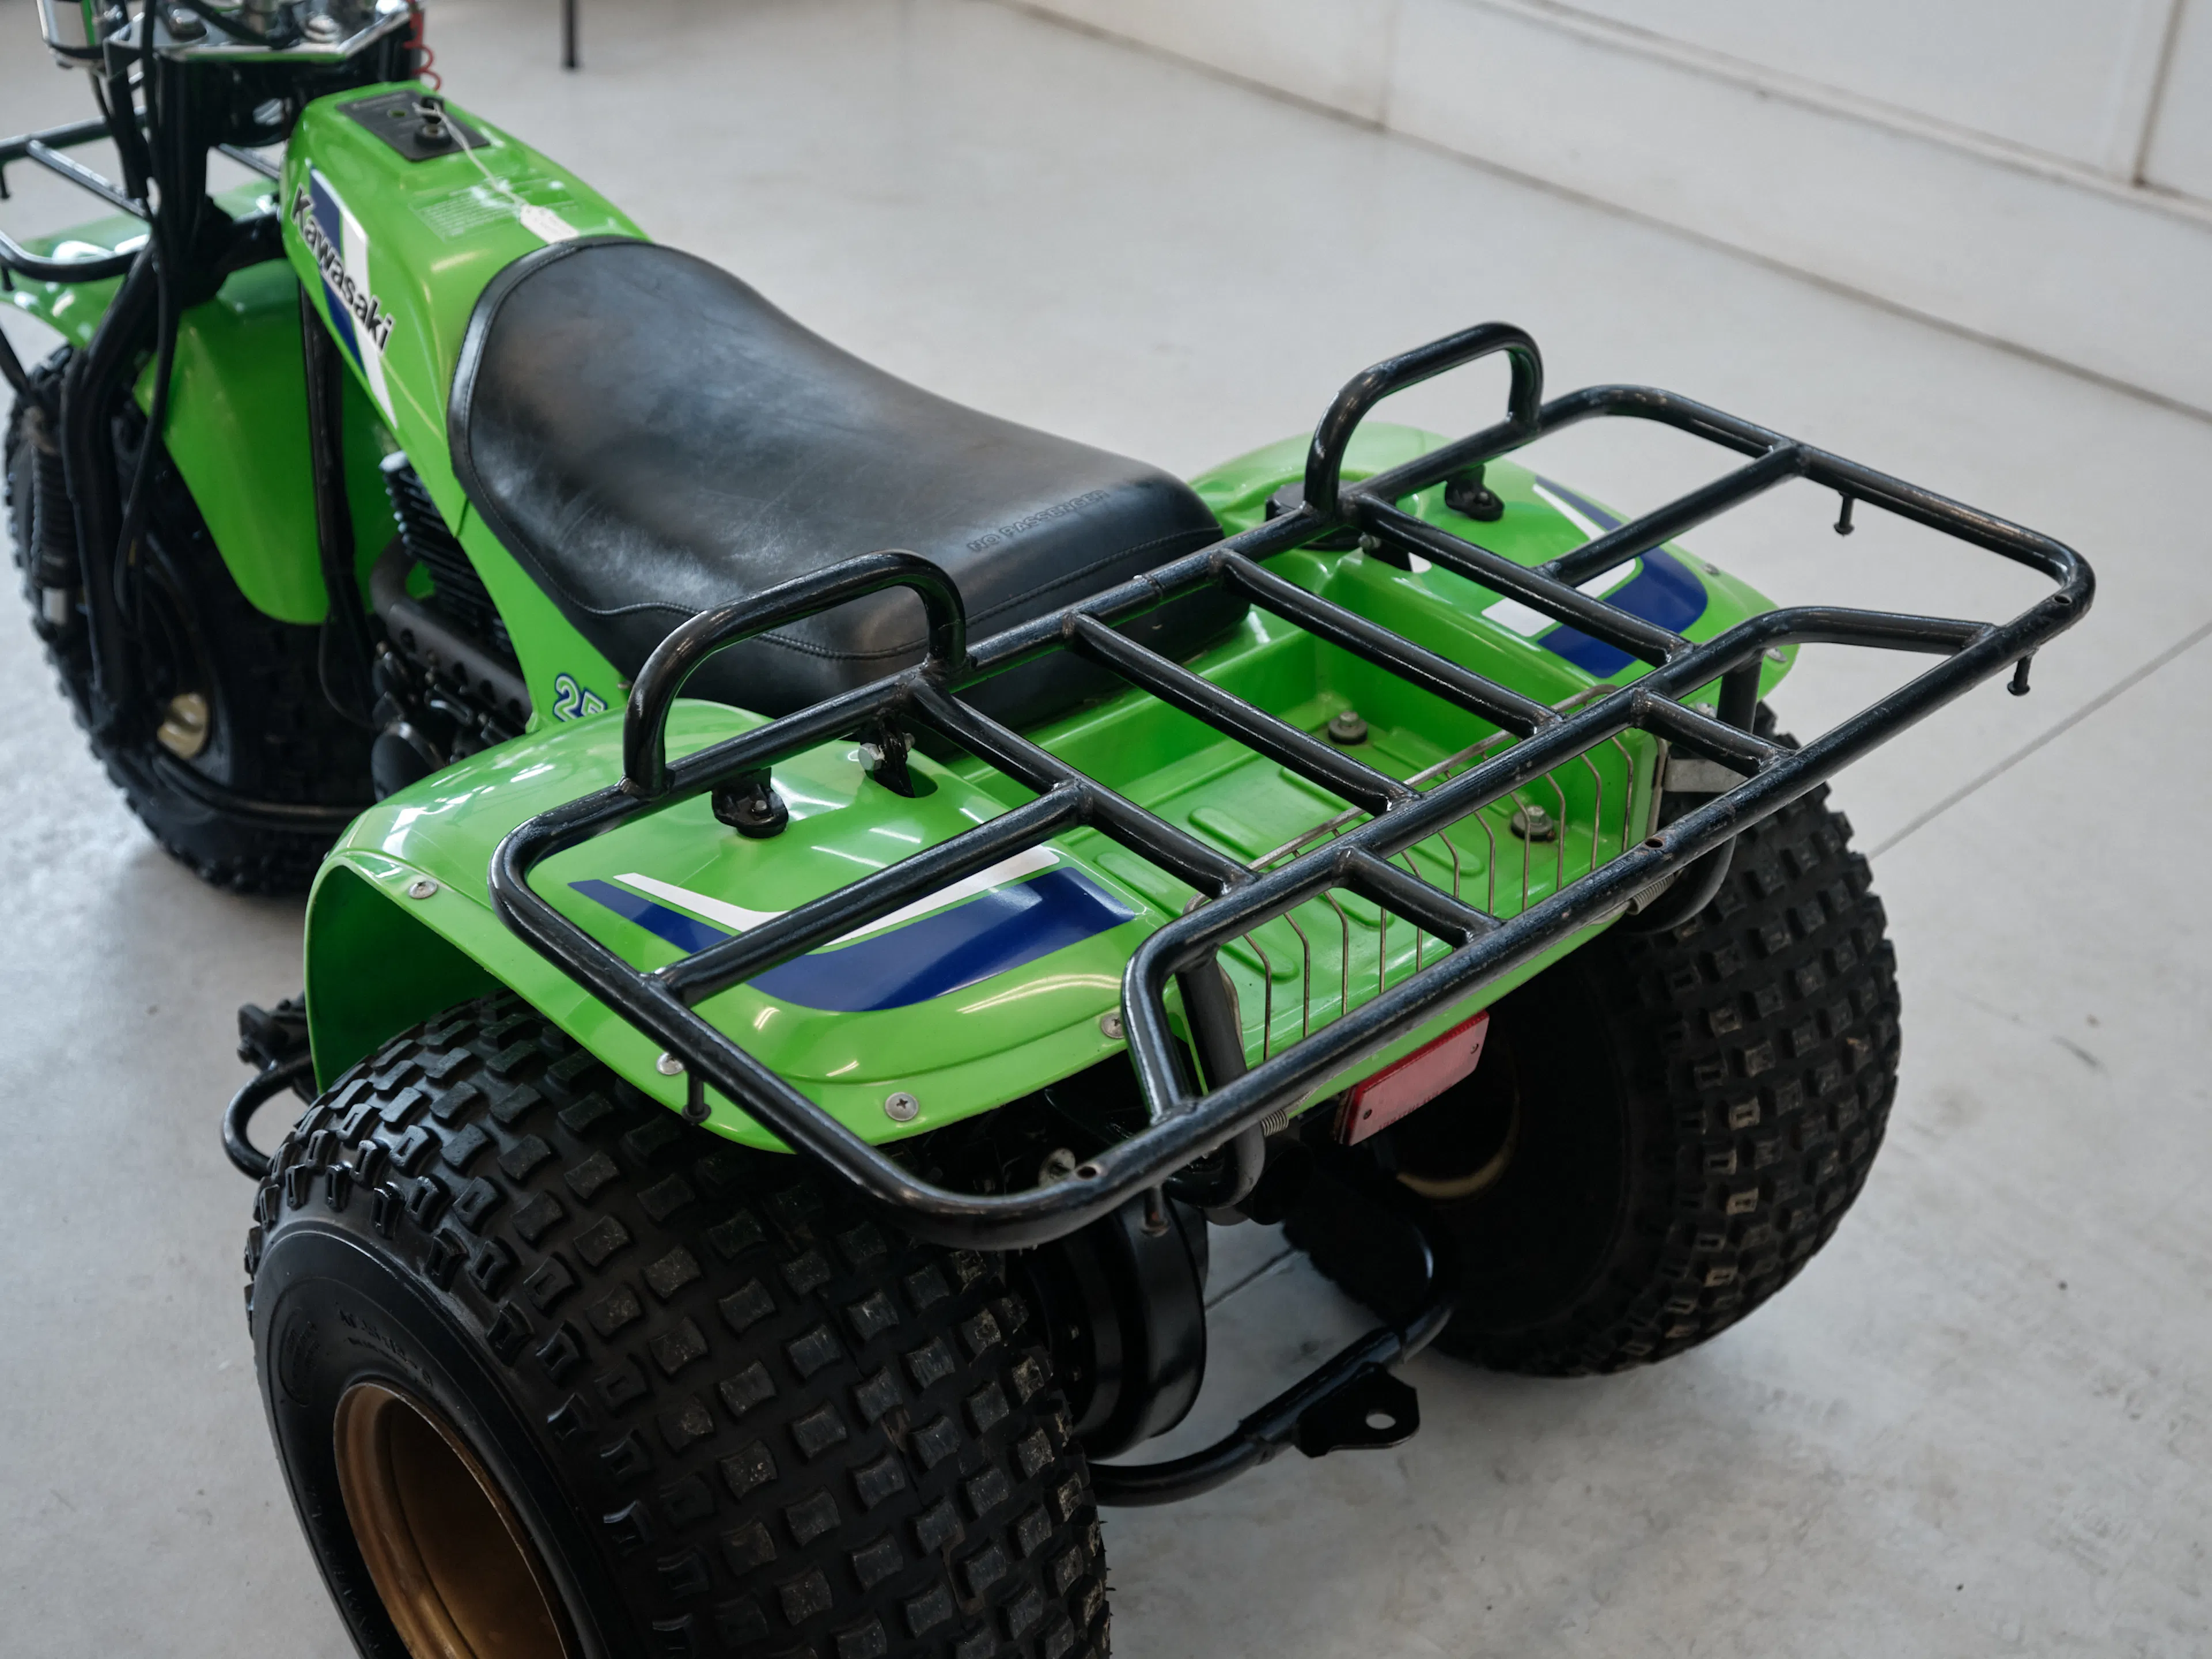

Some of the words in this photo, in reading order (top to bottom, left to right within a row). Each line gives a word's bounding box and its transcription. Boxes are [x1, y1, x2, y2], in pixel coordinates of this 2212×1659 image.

[291, 185, 393, 355] Kawasaki
[967, 533, 1001, 552] NO
[999, 489, 1111, 537] PASSENGER
